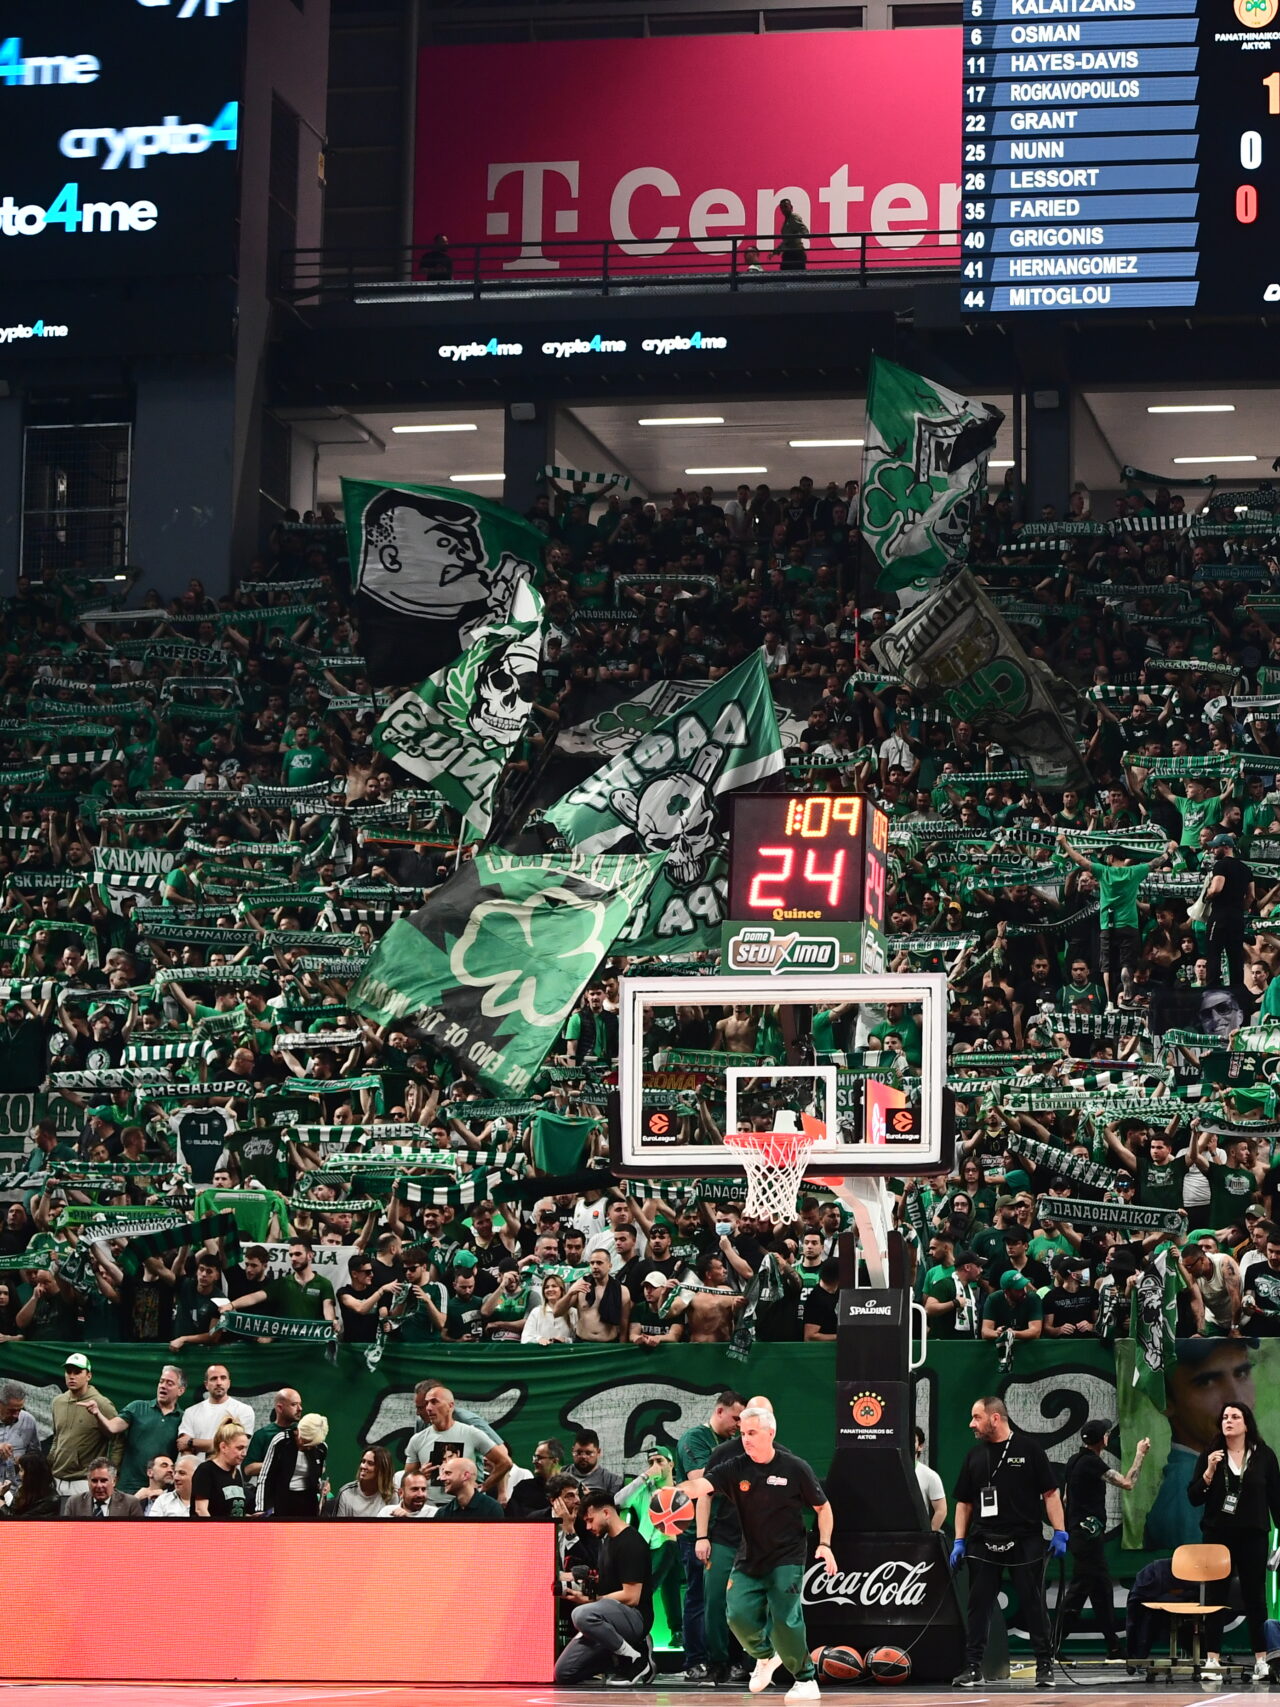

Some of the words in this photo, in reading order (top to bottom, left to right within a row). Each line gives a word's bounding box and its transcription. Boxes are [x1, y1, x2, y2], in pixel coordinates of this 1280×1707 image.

[970, 1, 982, 16] 5
[970, 29, 982, 44] 6
[1011, 25, 1080, 43] OSMAN
[1241, 41, 1271, 51] AKTOR
[966, 58, 985, 73] 11
[1011, 52, 1139, 72] HAYES-DAVIS
[966, 87, 985, 103] 17
[1010, 81, 1139, 101] ROGKAVOPOULOS
[965, 115, 985, 131] 22
[1010, 112, 1078, 130] GRANT
[965, 144, 985, 161] 25
[1010, 142, 1064, 159] NUNN
[1240, 130, 1262, 170] 0
[965, 173, 985, 190] 26
[1010, 170, 1099, 188] LESSORT
[610, 163, 961, 259] Center
[965, 203, 985, 219] 35
[1010, 199, 1080, 218] FARIED
[1236, 184, 1258, 224] 0
[964, 231, 985, 248] 40
[1009, 228, 1104, 247] GRIGONIS
[964, 261, 984, 278] 41
[1009, 257, 1138, 277] HERNANGOMEZ
[964, 290, 985, 307] 44
[1009, 287, 1111, 306] MITOGLOU
[438, 337, 523, 361] crypto4me
[541, 334, 627, 358] crypto4me
[642, 331, 728, 354] crypto4me
[148, 643, 228, 664] AMFISSA
[785, 797, 861, 838] 1:09
[937, 853, 969, 865] ΠΑΟ
[991, 853, 1023, 865] ΠΑΟ
[14, 874, 32, 889] SK
[35, 874, 75, 889] RAPID
[749, 848, 846, 908] 24
[772, 908, 822, 921] Quince
[743, 931, 769, 942] pame
[642, 1073, 697, 1091] ROMA
[193, 1138, 222, 1146] SUBARU
[642, 1135, 676, 1144] EuroLeague
[885, 1134, 920, 1142] EuroLeague
[1053, 1201, 1161, 1226] ΠΑΝΑΘΗΝΑΙΚΟΣ
[849, 1305, 892, 1316] SPALDING
[801, 1560, 935, 1607] Coca-Cola
